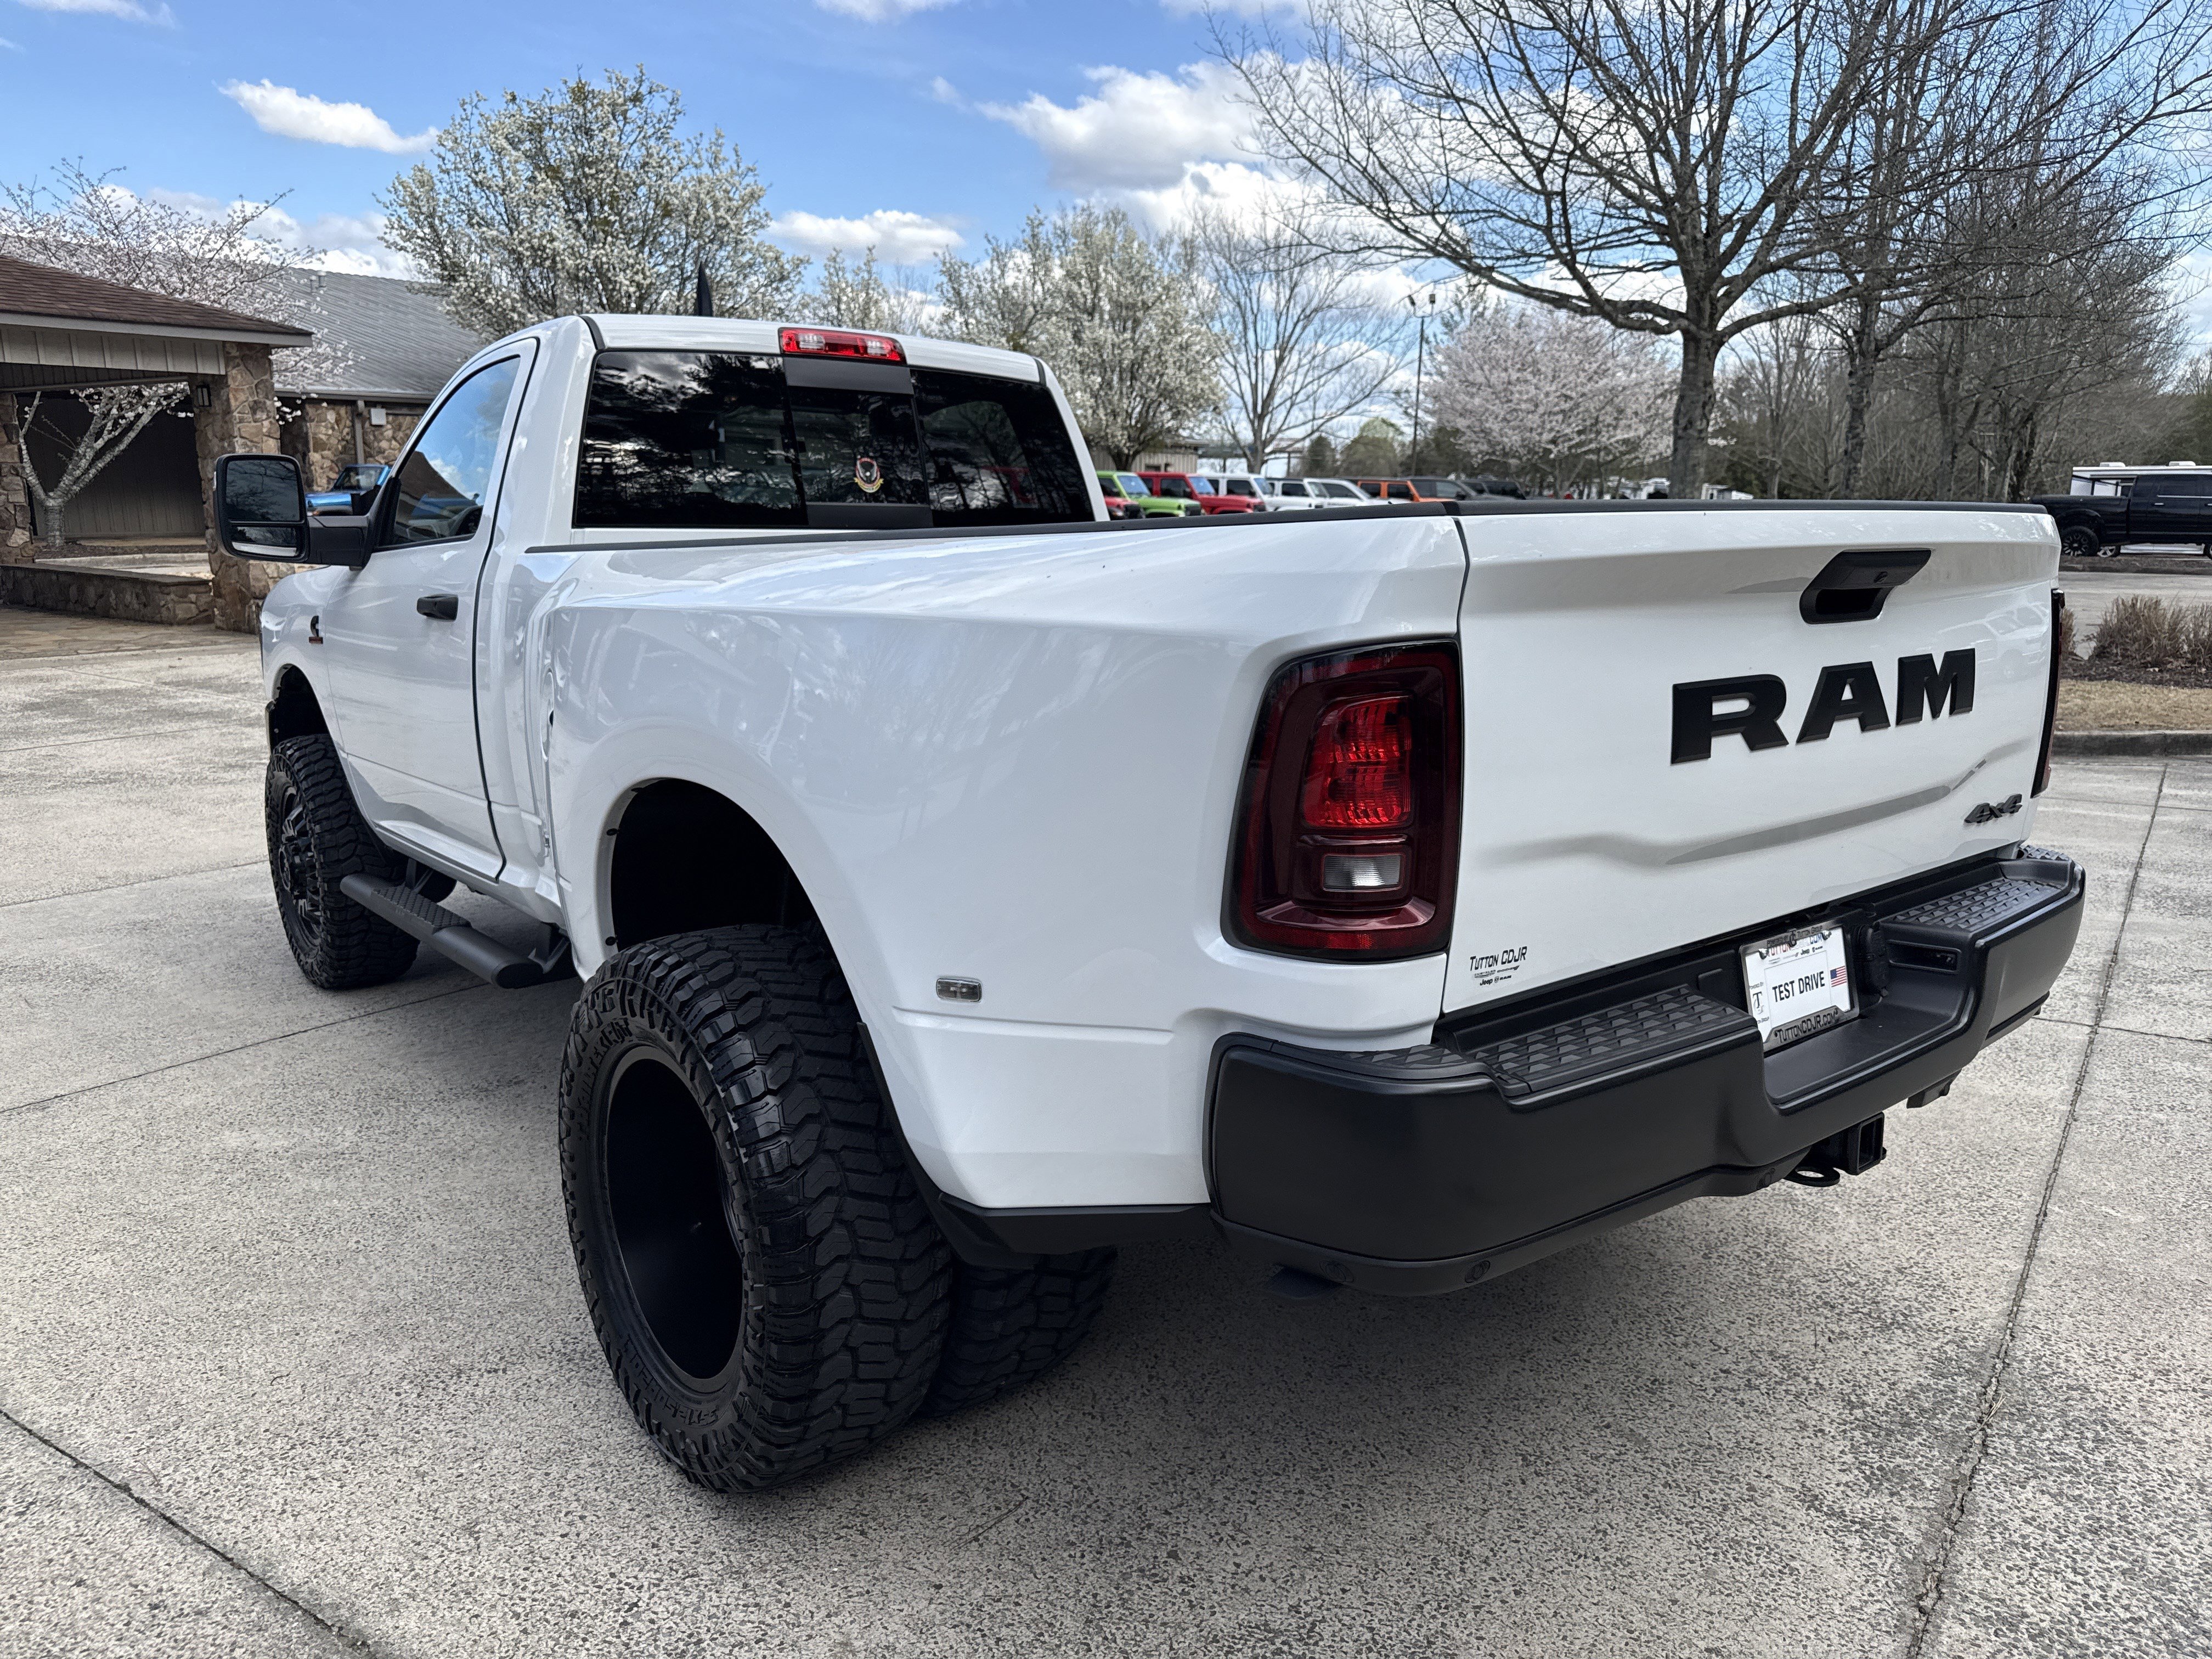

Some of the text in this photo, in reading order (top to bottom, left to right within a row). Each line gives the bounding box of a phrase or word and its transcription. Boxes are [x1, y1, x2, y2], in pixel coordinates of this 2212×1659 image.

[1671, 648, 1976, 765] RAM
[1964, 794, 2022, 823] 4x4
[1501, 946, 1527, 965] CDJR
[1772, 970, 1825, 1002] TEST DRIVE
